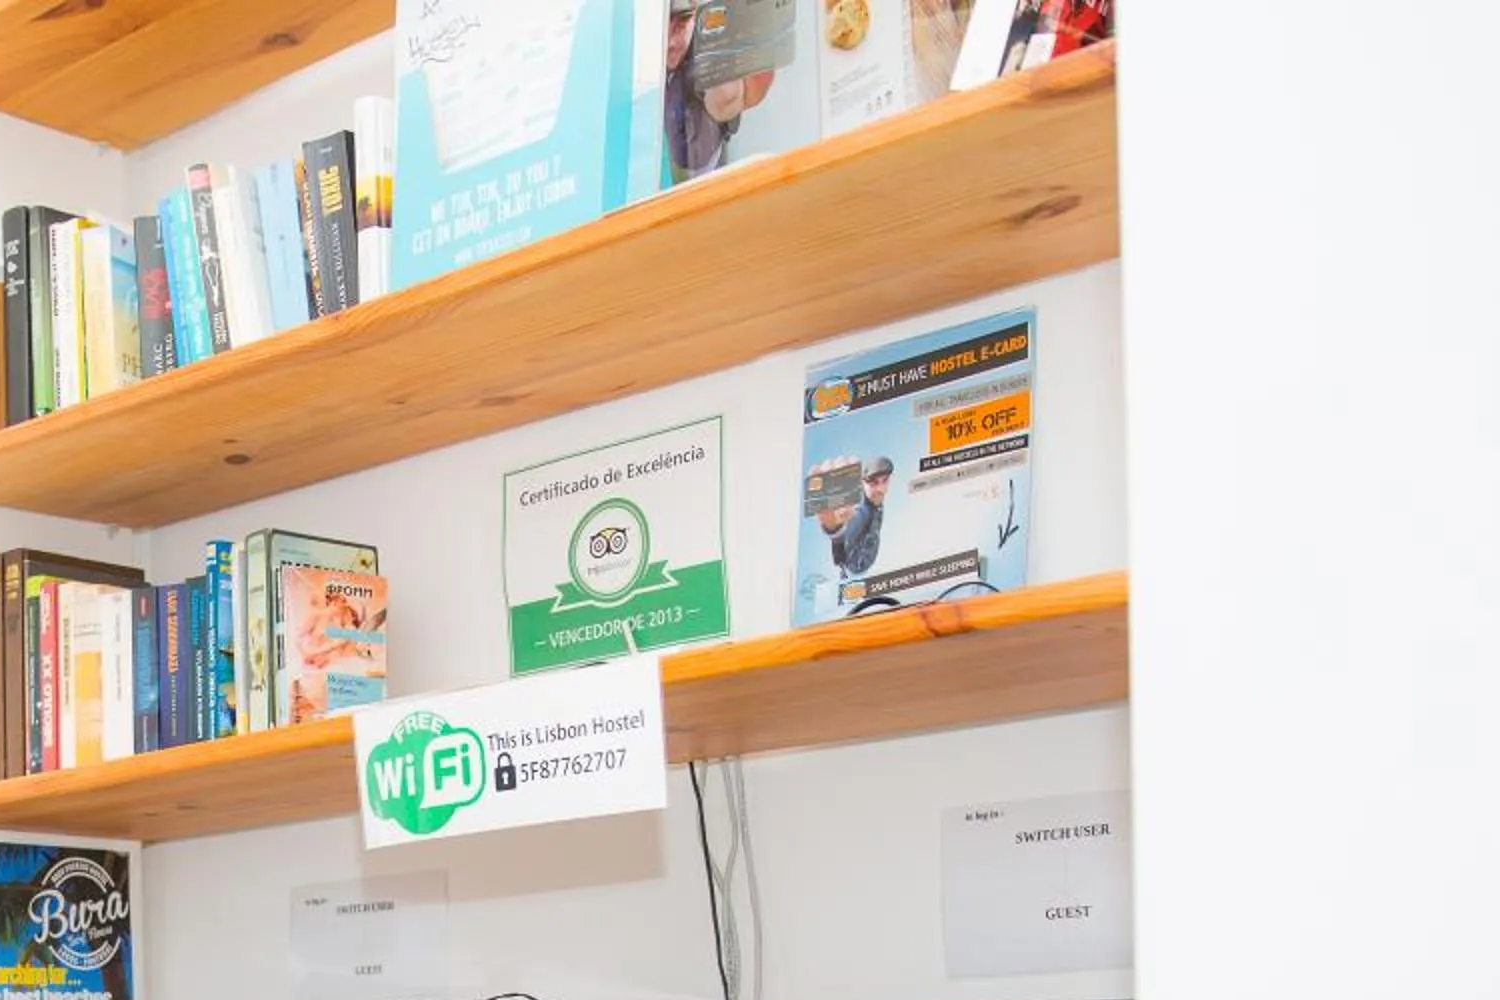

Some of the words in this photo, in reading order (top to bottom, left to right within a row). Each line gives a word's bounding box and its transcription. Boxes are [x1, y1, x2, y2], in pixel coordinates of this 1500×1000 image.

[318, 165, 343, 216] TOXIC
[866, 372, 897, 395] MUST
[899, 364, 929, 386] HAVE
[930, 350, 978, 376] HOSTEL
[980, 335, 1029, 361] E-CARD
[947, 419, 977, 441] 10%
[981, 406, 1017, 430] OFF
[519, 474, 599, 507] Certificado
[603, 467, 623, 485] de
[627, 445, 706, 479] Excelência
[548, 620, 623, 649] VENCEDOR
[629, 614, 644, 630] DE
[649, 606, 683, 628] 2013
[41, 652, 53, 678] XX
[393, 712, 445, 745] FREE
[487, 731, 517, 753] This
[520, 731, 533, 747] is
[536, 720, 587, 745] Lisbon
[592, 709, 645, 736] Hostel
[520, 747, 627, 784] 5F87762707
[1015, 827, 1071, 844] SWITCH
[1073, 823, 1111, 839] USER
[27, 889, 129, 943] Bura
[1045, 905, 1092, 921] GUEST
